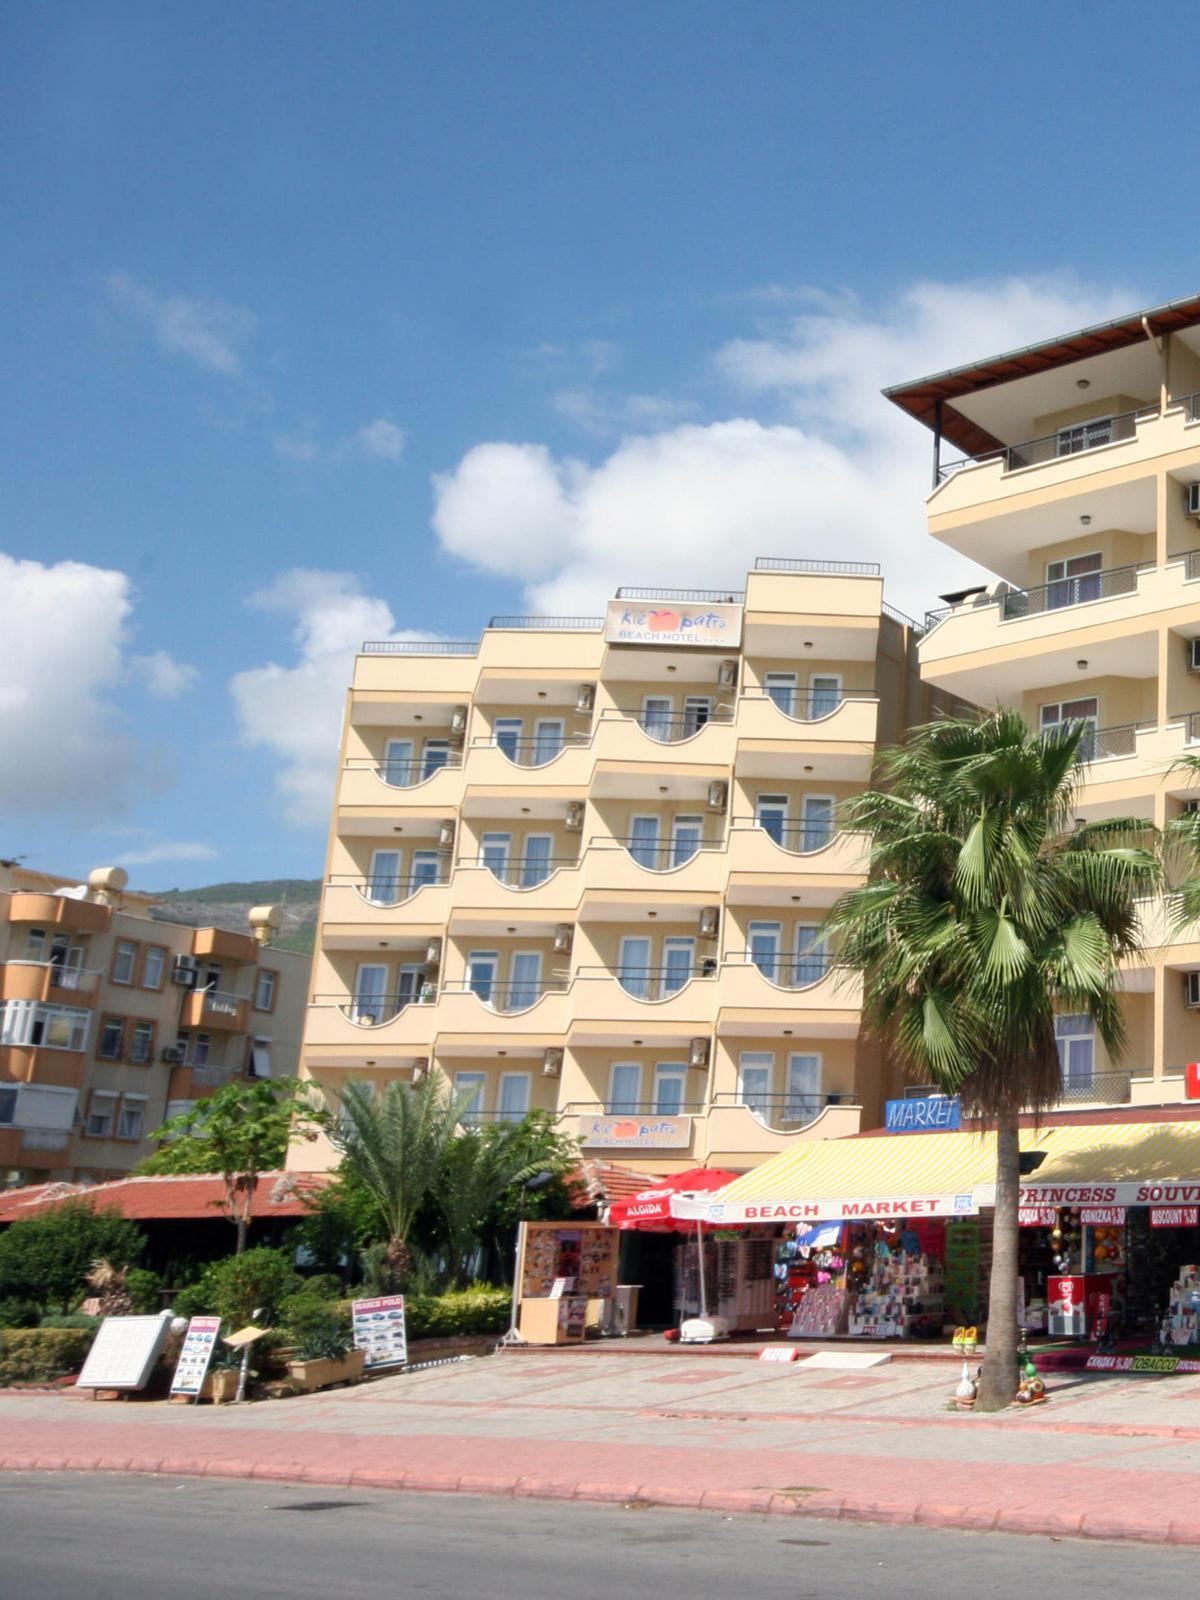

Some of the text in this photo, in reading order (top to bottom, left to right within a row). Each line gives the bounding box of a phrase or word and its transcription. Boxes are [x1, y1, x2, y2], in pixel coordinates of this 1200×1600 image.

[619, 631, 700, 642] BEACH HOTEL
[887, 1100, 957, 1127] MARKET
[745, 1204, 819, 1219] BEACH
[841, 1199, 941, 1216] MARKET
[1151, 1207, 1198, 1225] DISCOUNT %30
[1134, 1357, 1176, 1370] TOBACCO
